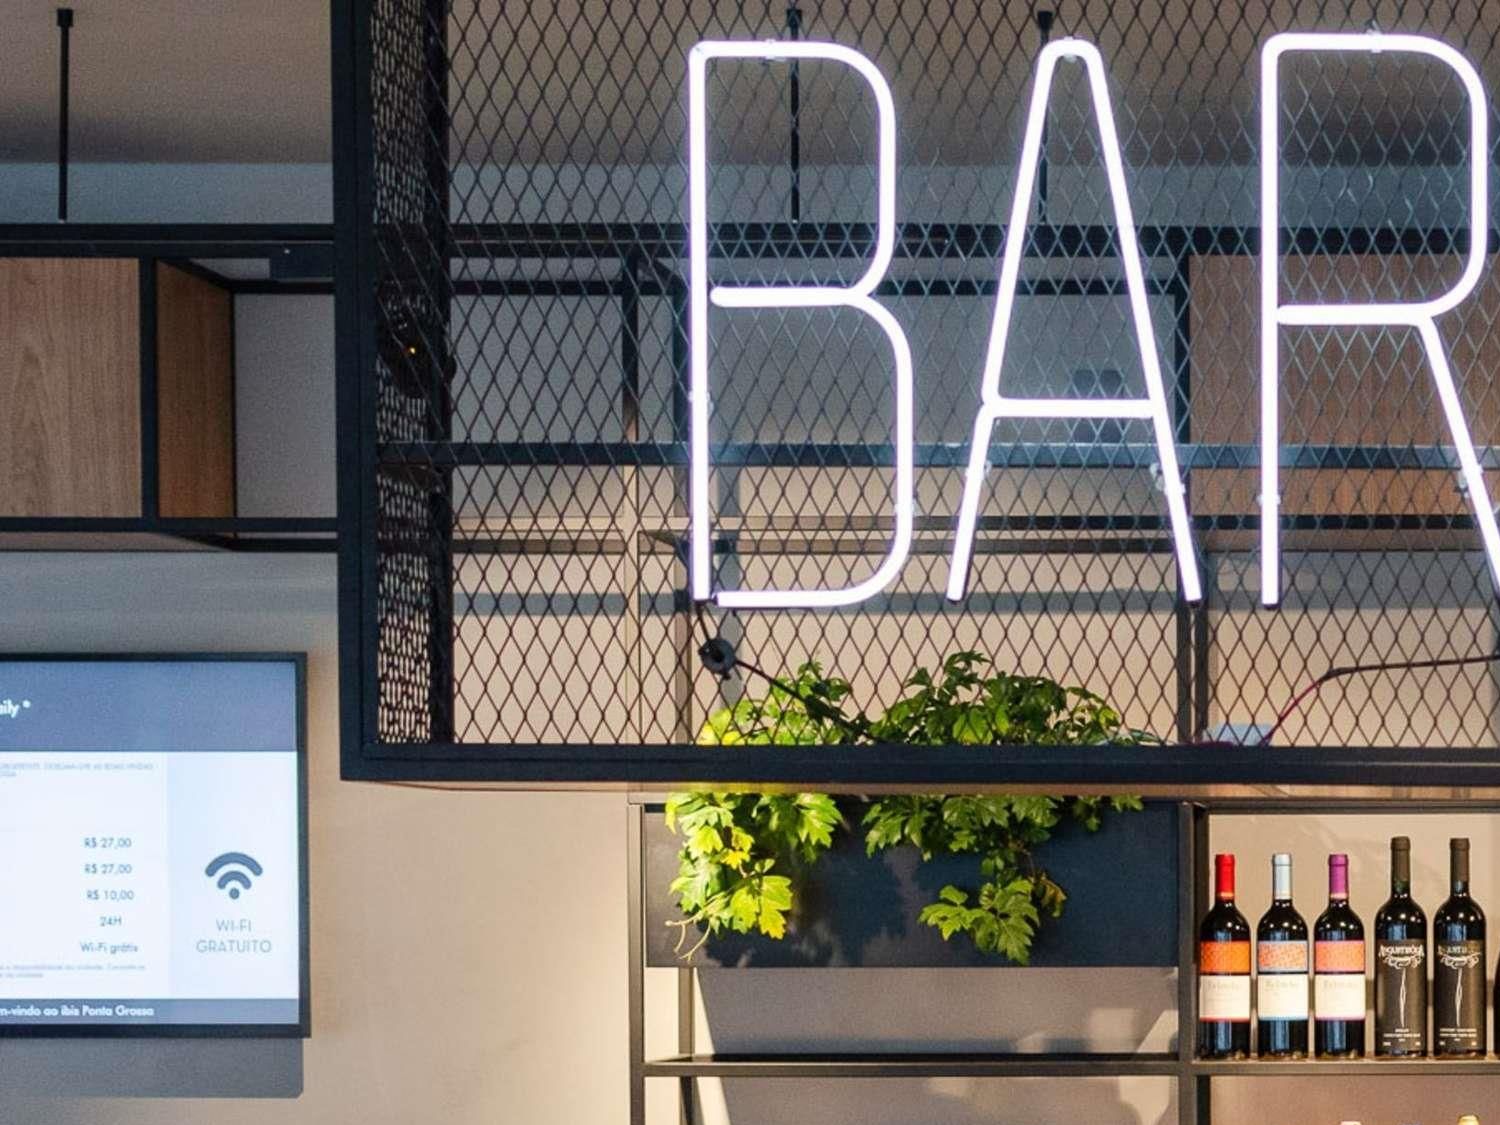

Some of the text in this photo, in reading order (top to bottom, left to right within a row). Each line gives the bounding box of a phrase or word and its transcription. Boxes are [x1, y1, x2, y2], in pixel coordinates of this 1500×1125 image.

[100, 837, 132, 850] 27,00
[100, 863, 132, 876] 27,00
[103, 889, 134, 902] 10,00
[216, 919, 252, 932] WI-FI
[195, 939, 272, 954] GRATUITO
[82, 1005, 112, 1016] Ponta
[115, 1005, 155, 1016] Grossa
